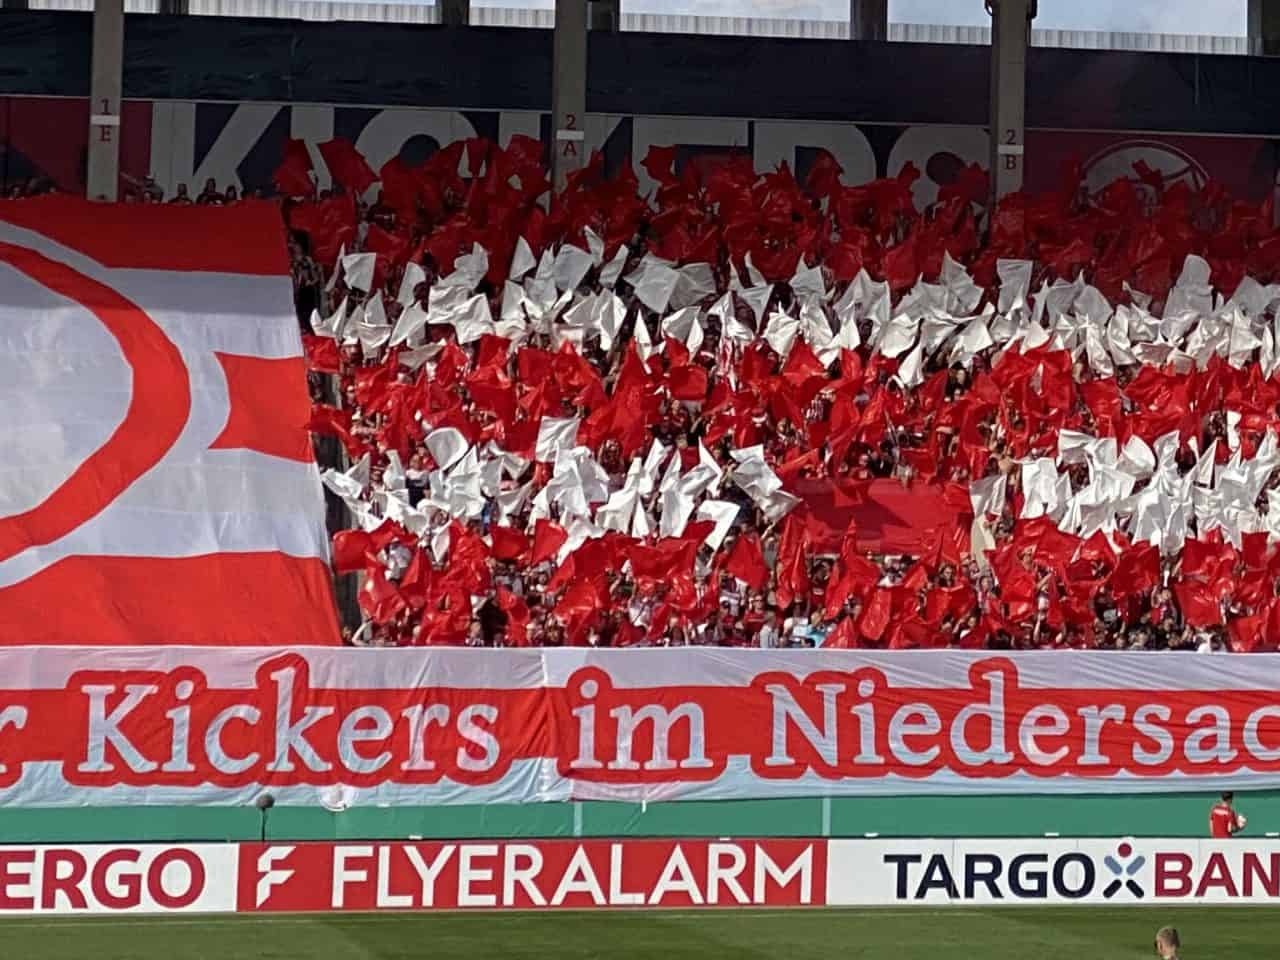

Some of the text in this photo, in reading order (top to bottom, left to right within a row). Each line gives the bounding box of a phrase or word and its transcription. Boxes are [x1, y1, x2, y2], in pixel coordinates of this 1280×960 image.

[101, 98, 110, 113] 1
[565, 114, 577, 130] 2
[100, 126, 111, 142] E
[1005, 130, 1016, 145] 2
[563, 141, 577, 157] A
[1005, 156, 1016, 170] B
[78, 666, 499, 773] Kickers
[570, 679, 714, 770] im
[0, 847, 205, 909] ERGO
[332, 843, 813, 907] FLYERALARM
